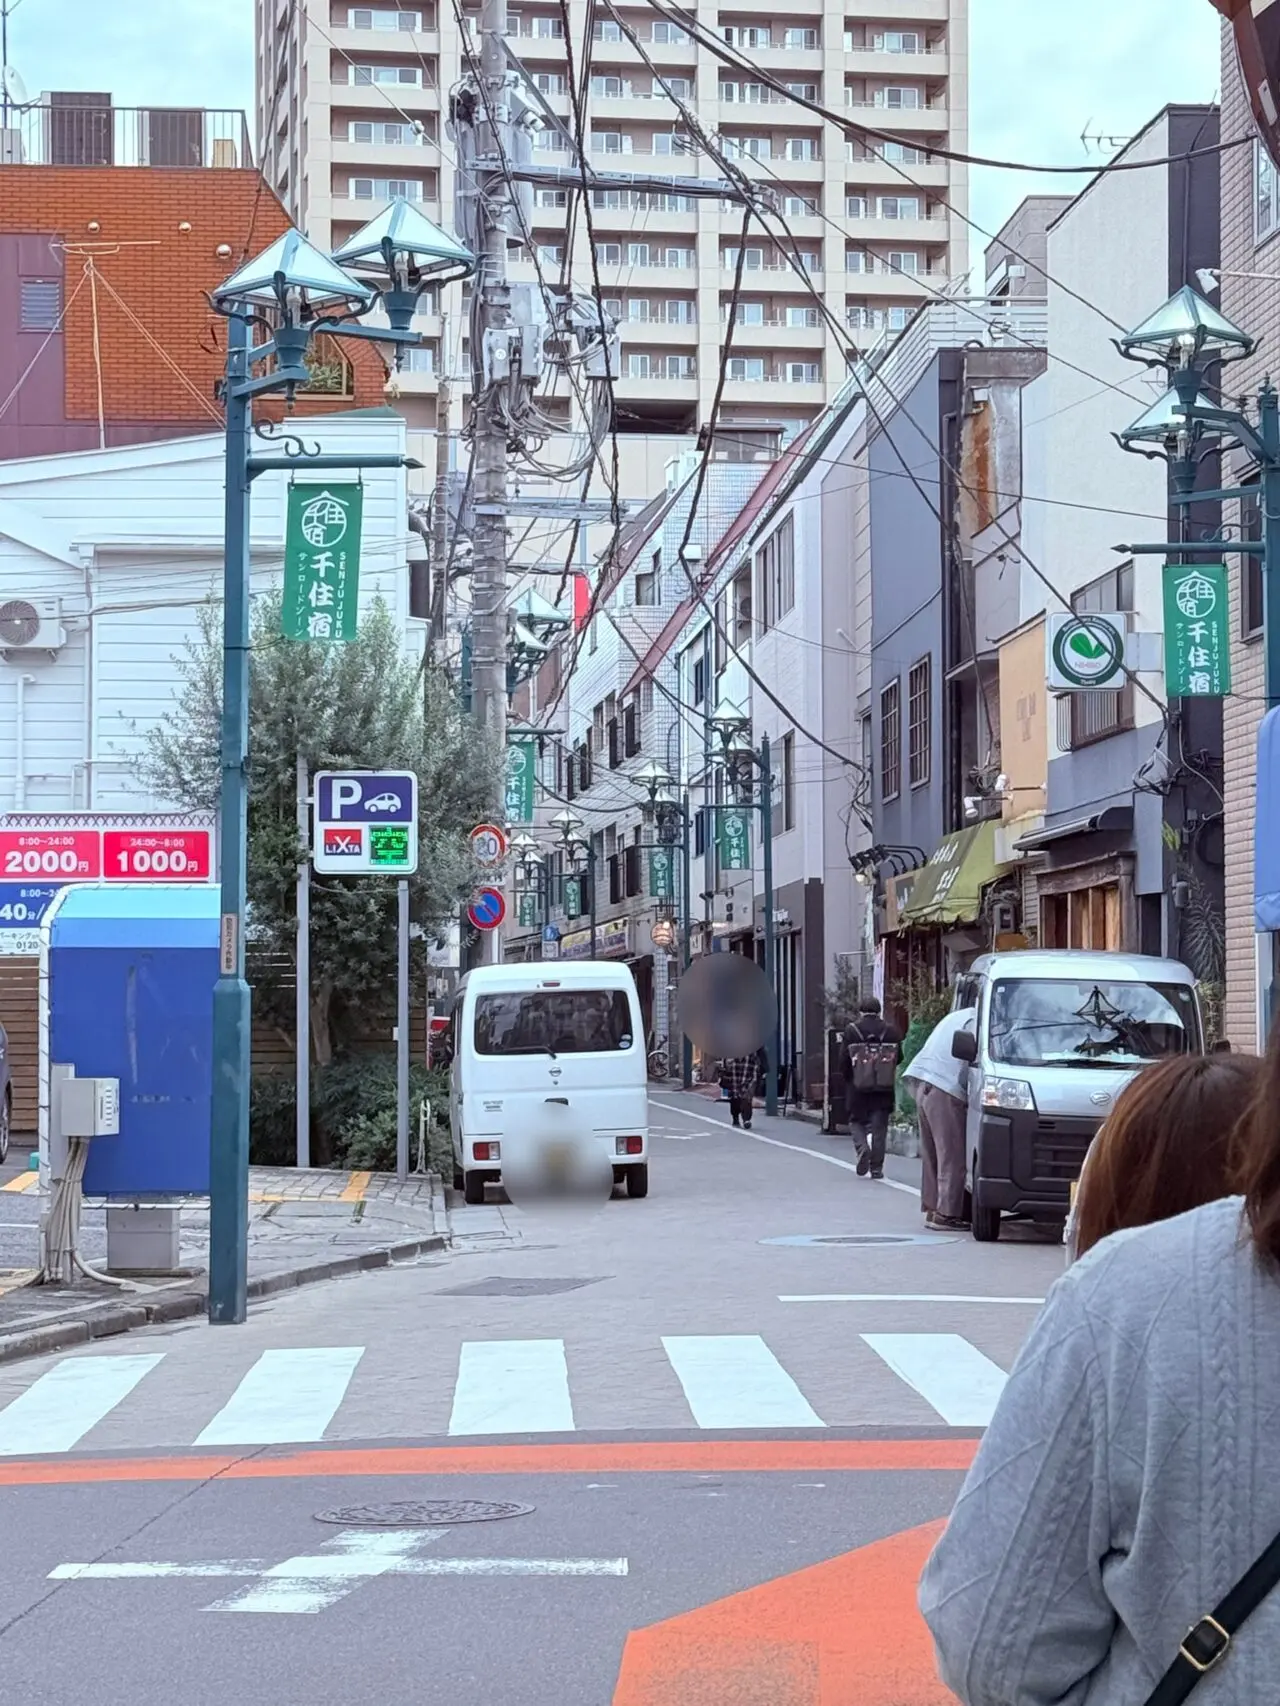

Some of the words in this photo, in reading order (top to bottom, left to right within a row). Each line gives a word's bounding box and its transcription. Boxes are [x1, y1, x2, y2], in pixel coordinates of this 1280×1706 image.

[307, 551, 335, 638] 千住宿
[1187, 621, 1211, 693] 千住宿
[331, 779, 362, 819] P
[325, 835, 360, 854] LIXTA
[5, 850, 89, 873] 2000円
[117, 850, 198, 873] 1000円
